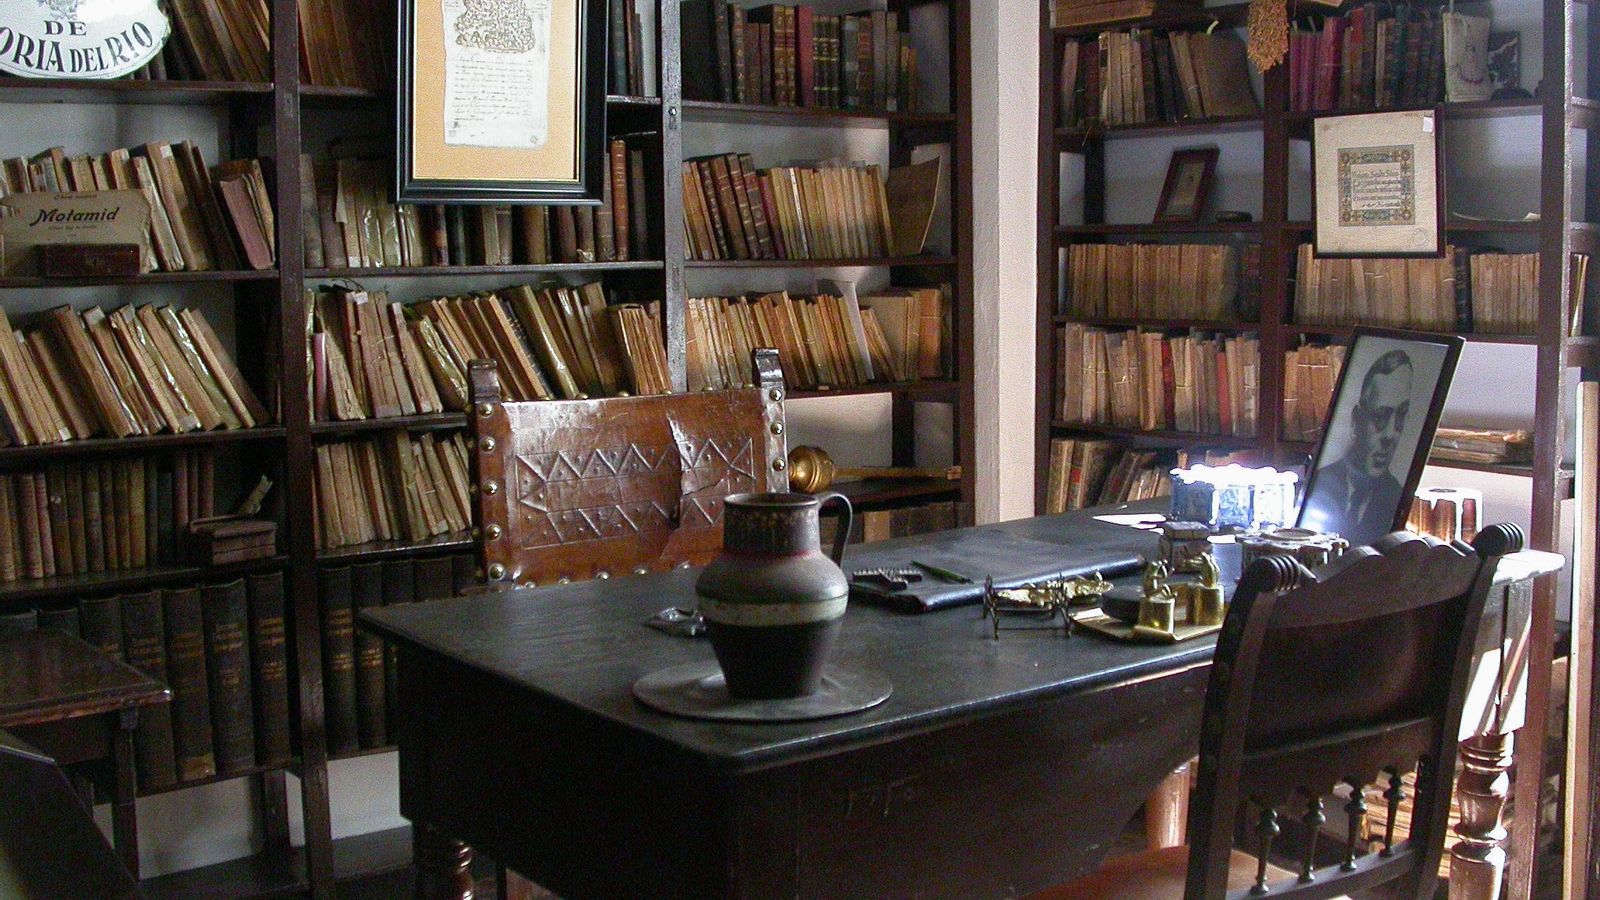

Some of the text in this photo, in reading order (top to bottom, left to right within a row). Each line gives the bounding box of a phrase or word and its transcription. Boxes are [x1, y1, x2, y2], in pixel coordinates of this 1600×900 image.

[44, 20, 87, 36] DE
[69, 46, 109, 73] DEL
[104, 21, 153, 66] RIO
[29, 207, 120, 227] Motamid
